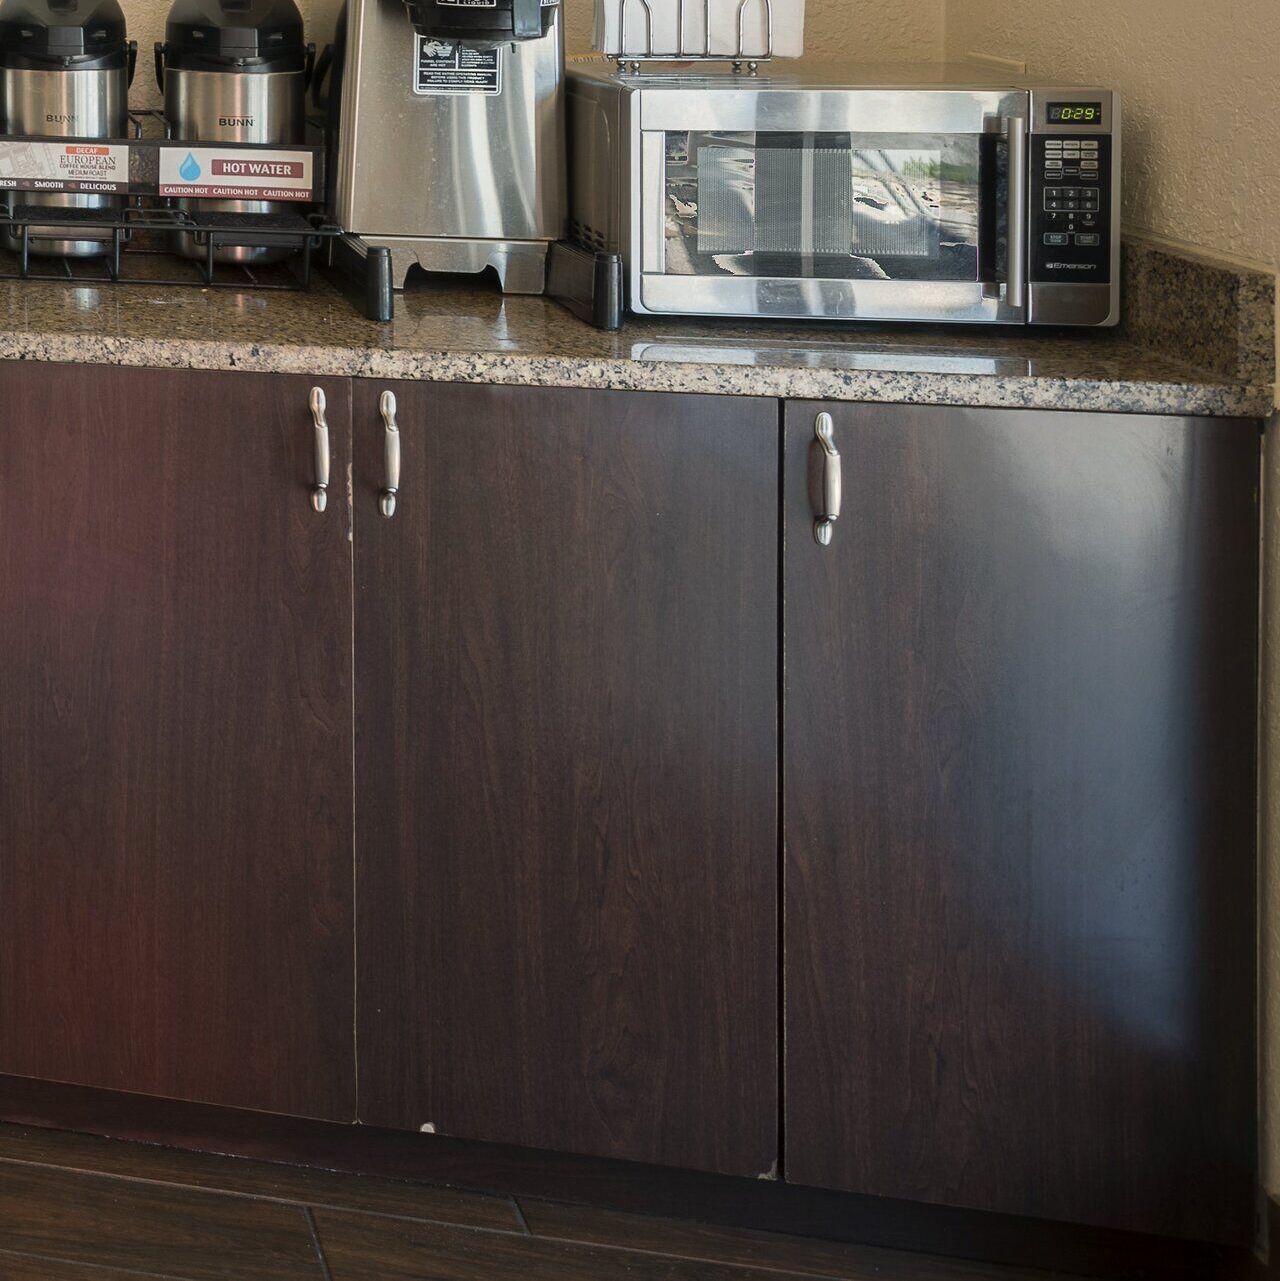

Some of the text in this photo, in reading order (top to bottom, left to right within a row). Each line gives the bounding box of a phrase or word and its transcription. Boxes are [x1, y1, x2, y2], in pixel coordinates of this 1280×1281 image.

[1062, 108, 1094, 119] 0:29
[46, 115, 78, 123] BUNN
[219, 118, 254, 126] BUNN
[60, 155, 116, 165] EUROPEAN
[223, 163, 291, 175] HOT WATER
[80, 183, 116, 191] DELICIOUS
